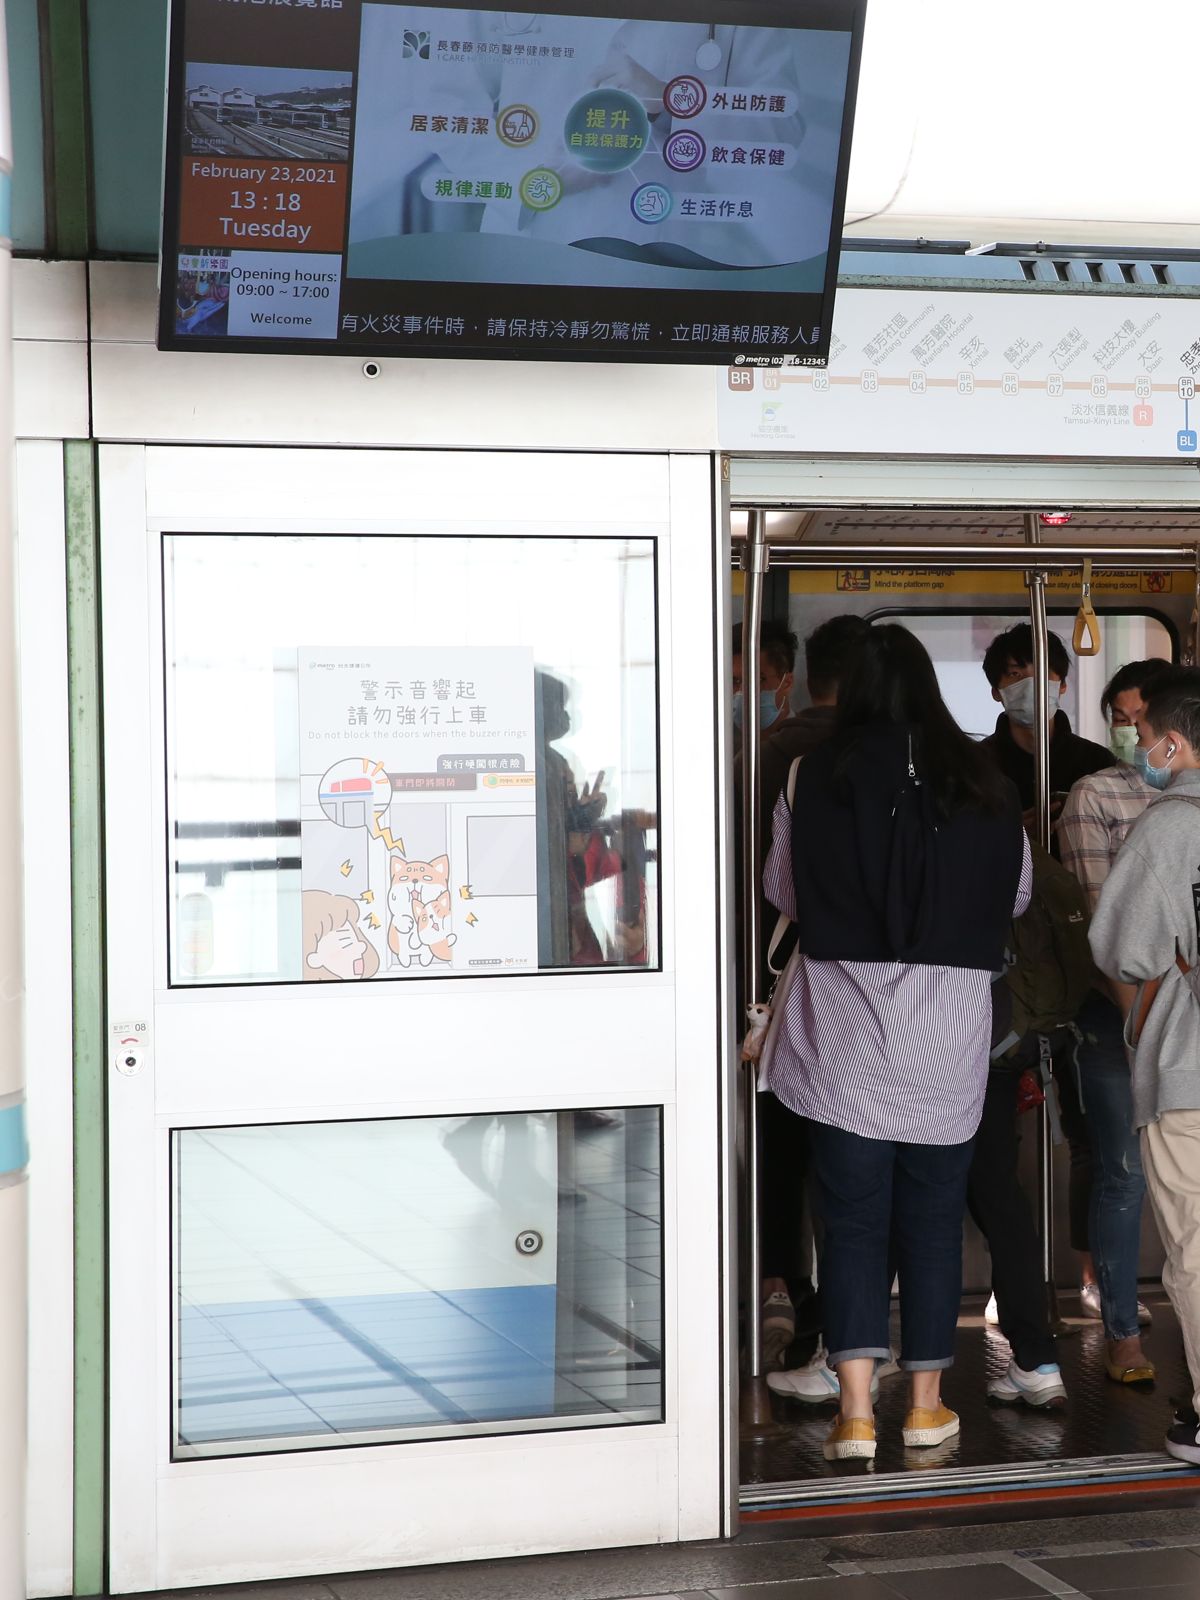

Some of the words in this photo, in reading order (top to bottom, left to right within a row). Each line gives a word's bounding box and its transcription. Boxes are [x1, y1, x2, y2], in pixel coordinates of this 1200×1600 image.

[712, 93, 786, 112] 外出防護
[410, 114, 489, 135] 居家清潔
[586, 109, 631, 129] 提升
[570, 132, 643, 149] 自我保護力
[711, 147, 785, 165] 飲食保健
[192, 163, 265, 183] February
[270, 167, 336, 184] 23,2021
[435, 179, 512, 199] 規律運動
[680, 199, 754, 218] 生活作息
[219, 218, 311, 243] Tuesday
[231, 267, 290, 283] Opening
[295, 270, 337, 282] hours:
[237, 285, 274, 296] 09:00
[293, 286, 329, 298] 17:00
[251, 313, 312, 325] Welcome
[862, 312, 908, 360] 萬芳社區
[873, 340, 902, 367] Wanfang
[900, 303, 935, 335] Community
[910, 313, 957, 360] 萬芳醫院
[921, 339, 949, 368] Wanfang
[948, 313, 974, 339] Hospital
[1093, 319, 1137, 365] 科技大樓
[1101, 337, 1138, 372] Technology
[1136, 312, 1162, 338] Building
[958, 335, 985, 362] 辛亥
[1014, 340, 1043, 370] Linguang
[1058, 339, 1090, 371] Liuzhangli
[1137, 340, 1162, 366] 大安
[969, 349, 989, 369] Xinhai
[1145, 356, 1164, 374] Daan
[731, 372, 750, 384] BR
[814, 380, 827, 388] 02
[863, 381, 876, 390] 03
[911, 383, 925, 391] 04
[959, 383, 972, 392] 05
[1004, 384, 1017, 393] 06
[1049, 385, 1061, 394] 07
[1093, 386, 1105, 395] 08
[1137, 387, 1149, 396] 09
[1181, 388, 1192, 397] 10
[1072, 404, 1129, 416] 淡水信義線
[1140, 412, 1147, 420] R
[1180, 436, 1194, 445] BL
[360, 678, 476, 700] 警示音響起
[348, 705, 487, 725] 請勿強行上車
[308, 731, 321, 739] Do
[344, 730, 369, 739] block
[374, 730, 389, 738] the
[392, 730, 419, 738] doors
[422, 730, 448, 738] when
[452, 729, 466, 738] the
[470, 729, 500, 737] buzzer
[504, 729, 527, 739] rings
